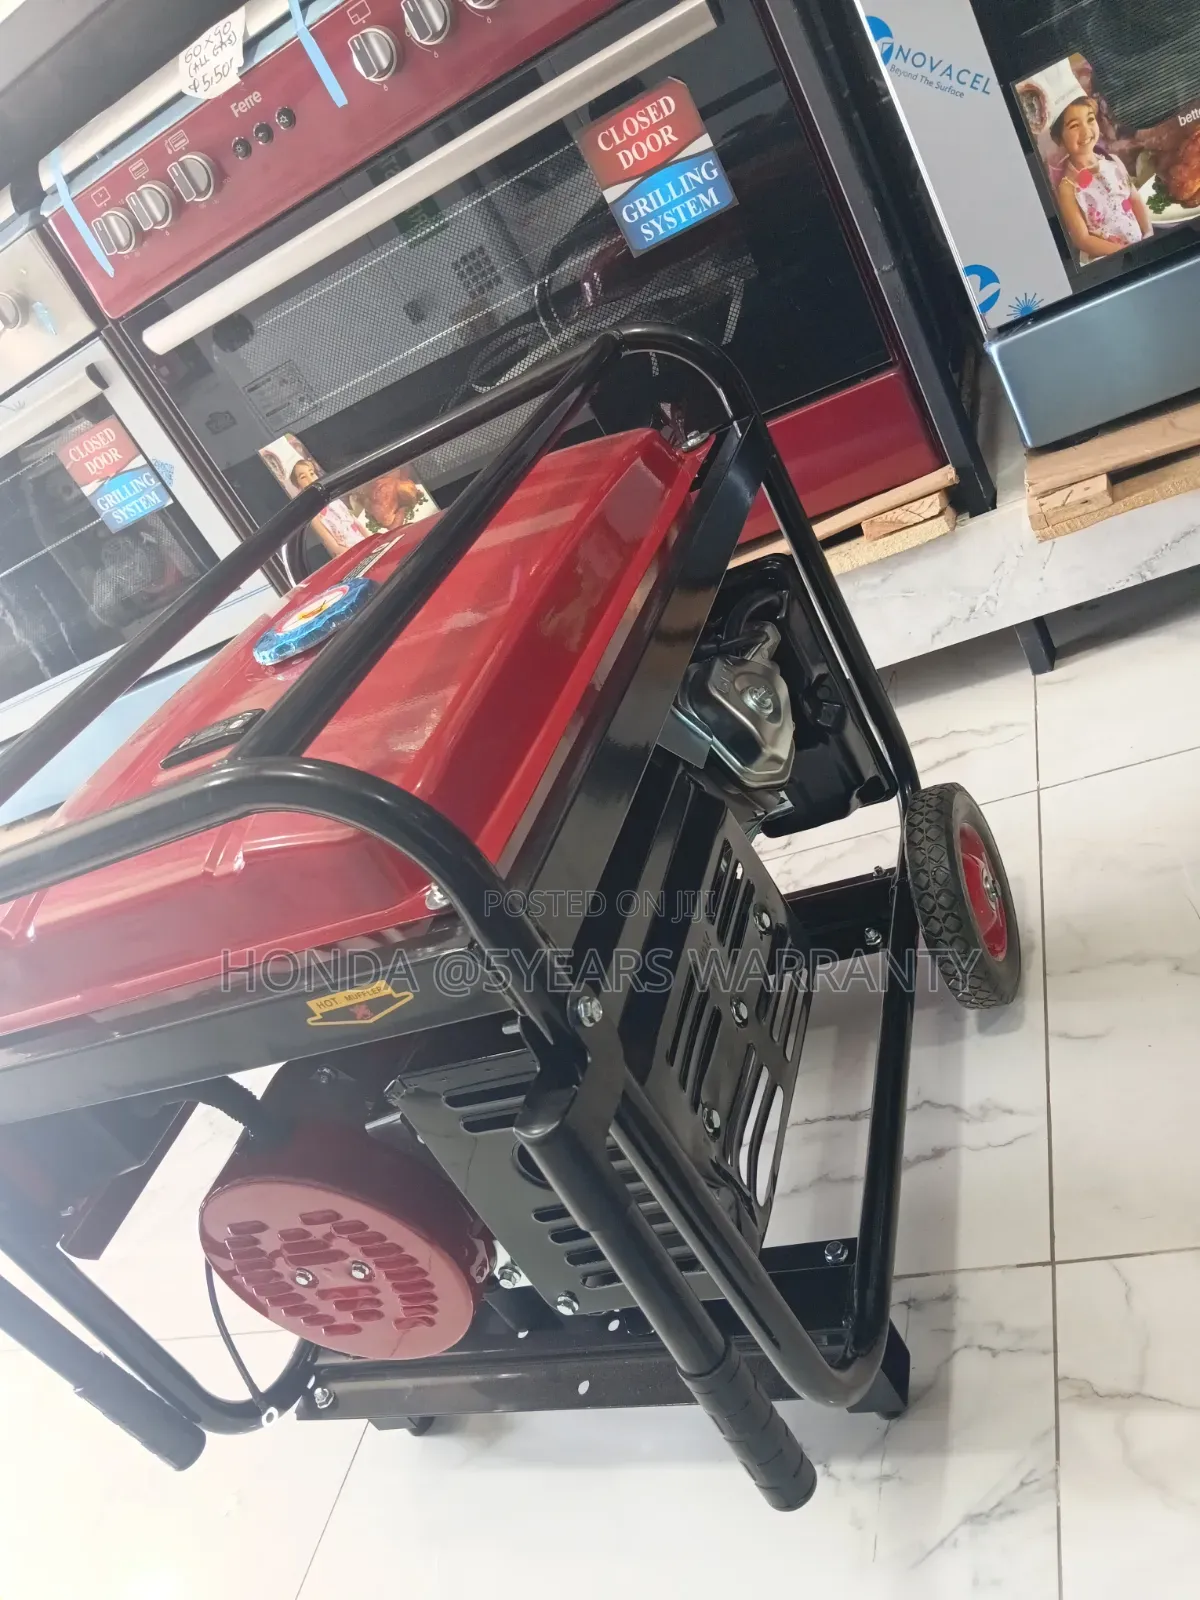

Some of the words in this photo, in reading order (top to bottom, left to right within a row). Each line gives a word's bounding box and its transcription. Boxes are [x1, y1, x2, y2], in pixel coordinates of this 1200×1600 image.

[889, 64, 919, 81] Beyond
[919, 75, 934, 87] The
[934, 81, 965, 99] Surface
[894, 44, 991, 95] NOVACEL
[230, 90, 262, 118] Ferre
[597, 95, 676, 151] CLOSED
[616, 124, 679, 171] DOOR
[621, 159, 719, 223] GRILLING
[640, 187, 721, 242] SYSTEM
[68, 427, 116, 462] CLOSED
[84, 447, 123, 476] DOOR
[96, 472, 156, 511] GRILLING
[111, 490, 162, 524] SYSTEM
[344, 986, 382, 1002] MUFFLER
